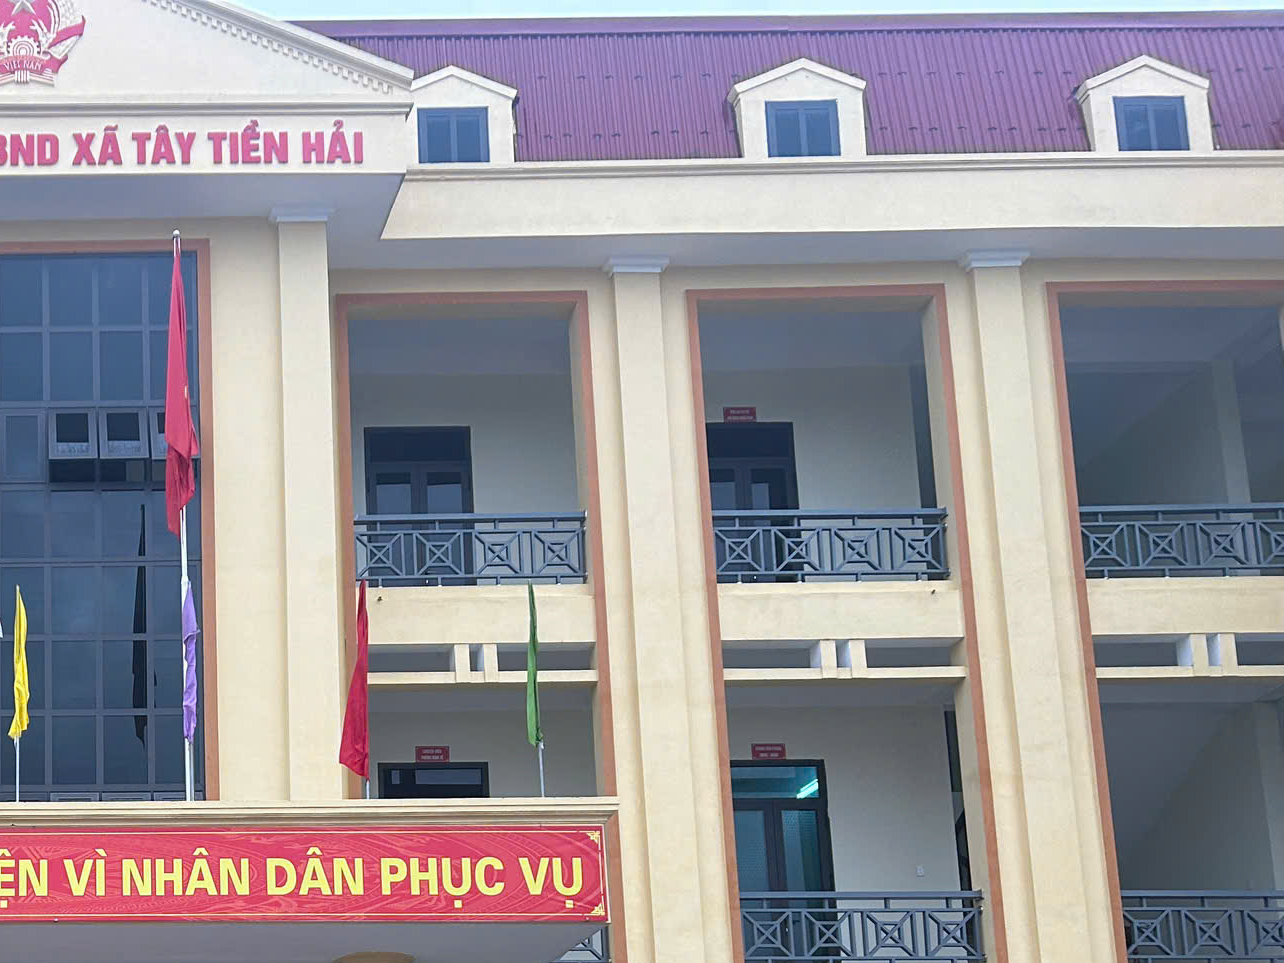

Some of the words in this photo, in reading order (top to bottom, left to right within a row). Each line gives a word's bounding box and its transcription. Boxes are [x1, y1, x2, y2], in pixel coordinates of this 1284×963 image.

[72, 124, 123, 165] XÃ
[132, 125, 197, 164] TÂY
[207, 119, 289, 164] TIỀN
[302, 119, 364, 164] HẢI
[63, 848, 108, 897] VÌ
[122, 847, 251, 896] NHÂN
[266, 846, 364, 896] DÂN
[380, 855, 505, 909] PHỤC
[518, 856, 584, 909] VỤ
